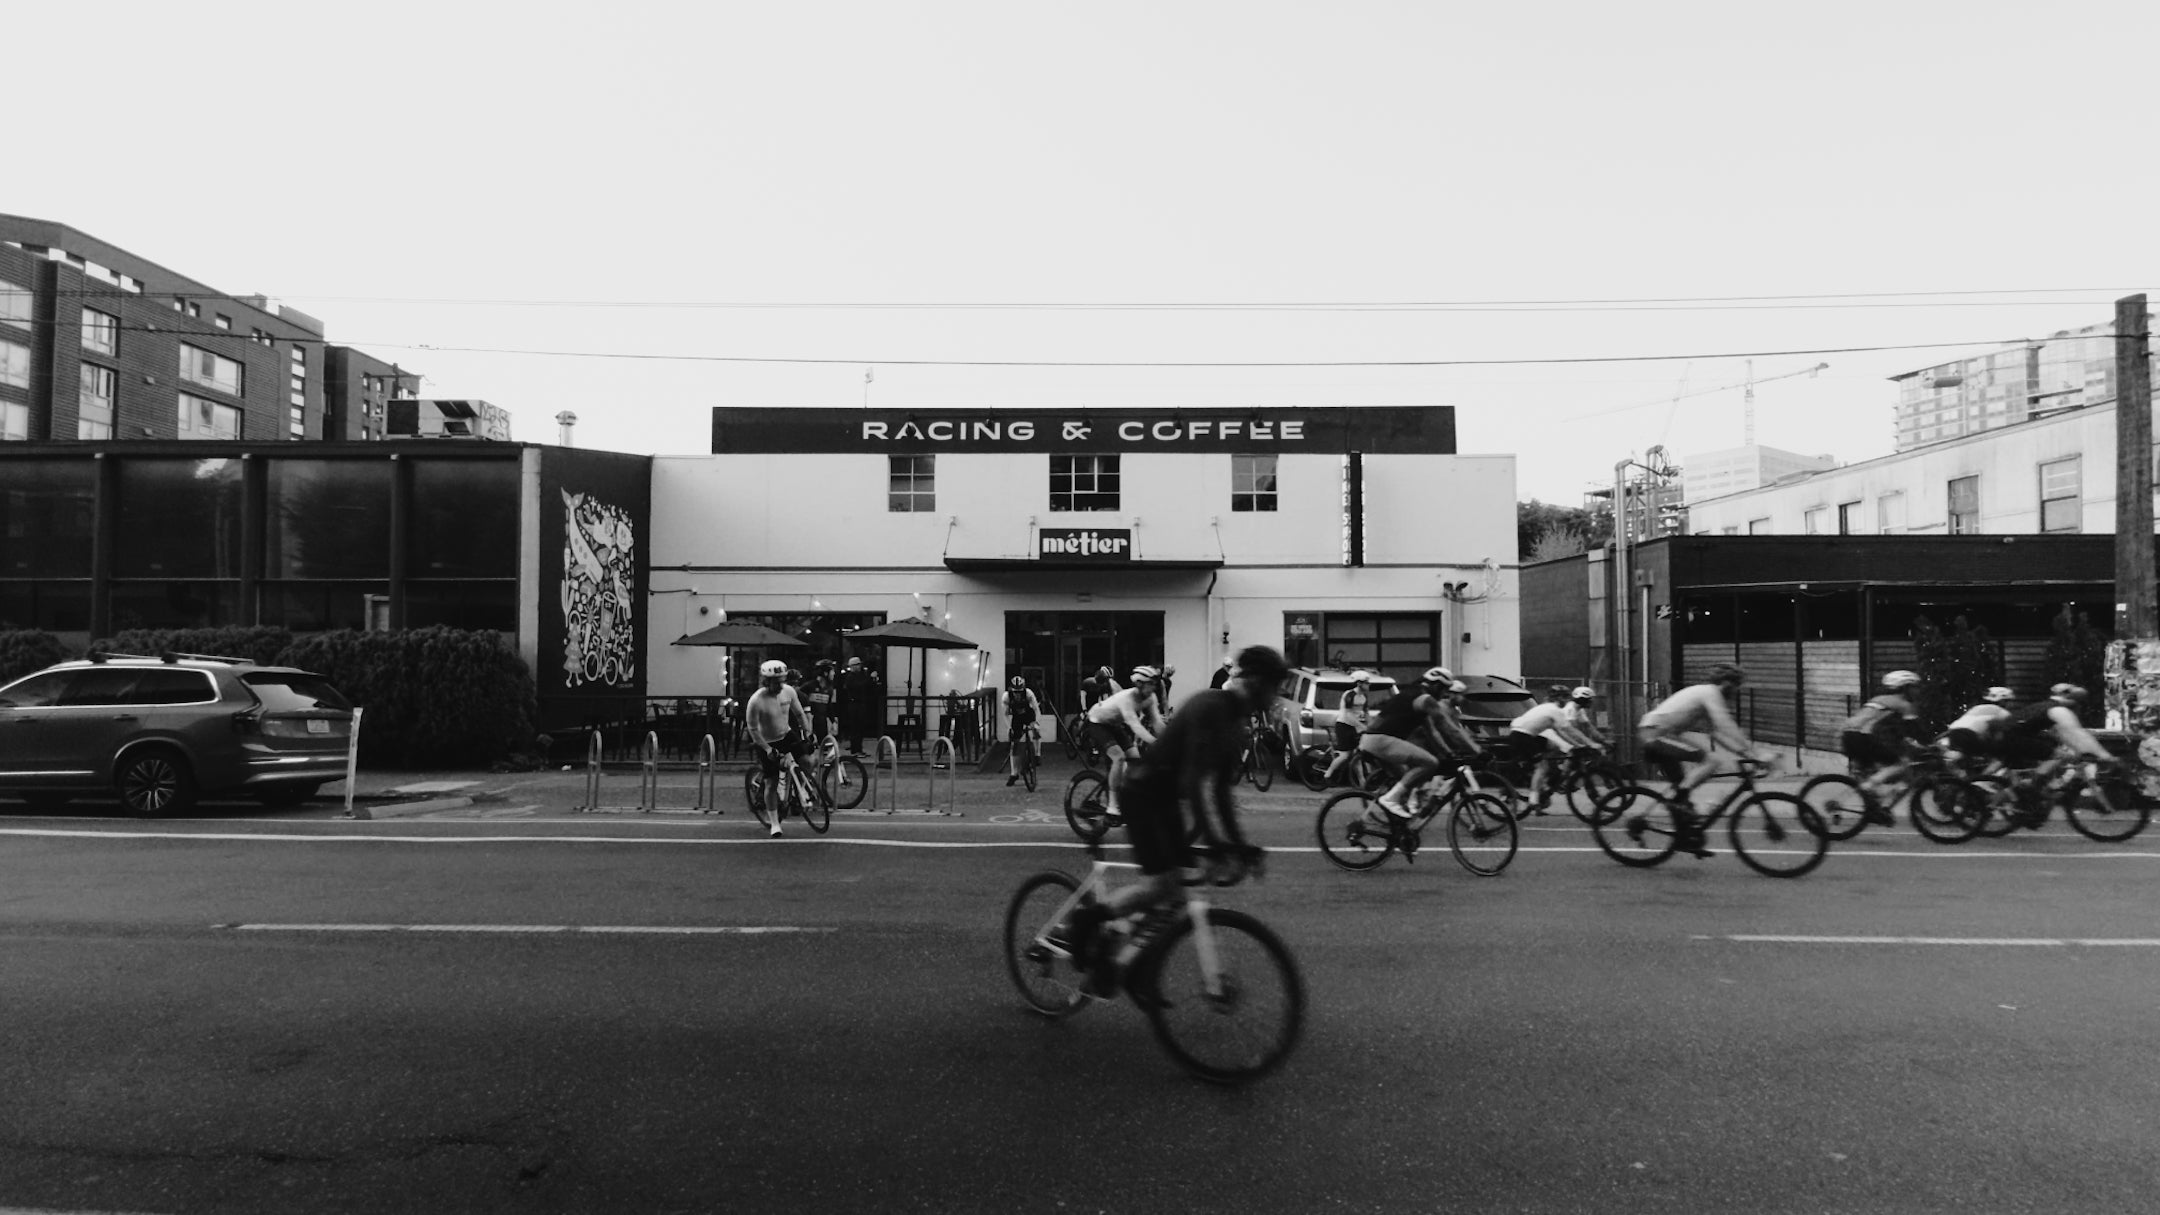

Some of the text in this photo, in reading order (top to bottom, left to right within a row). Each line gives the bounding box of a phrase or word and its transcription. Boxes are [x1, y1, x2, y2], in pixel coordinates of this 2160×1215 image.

[862, 419, 1305, 441] RACING & COFFEE
[1042, 531, 1128, 556] métier
